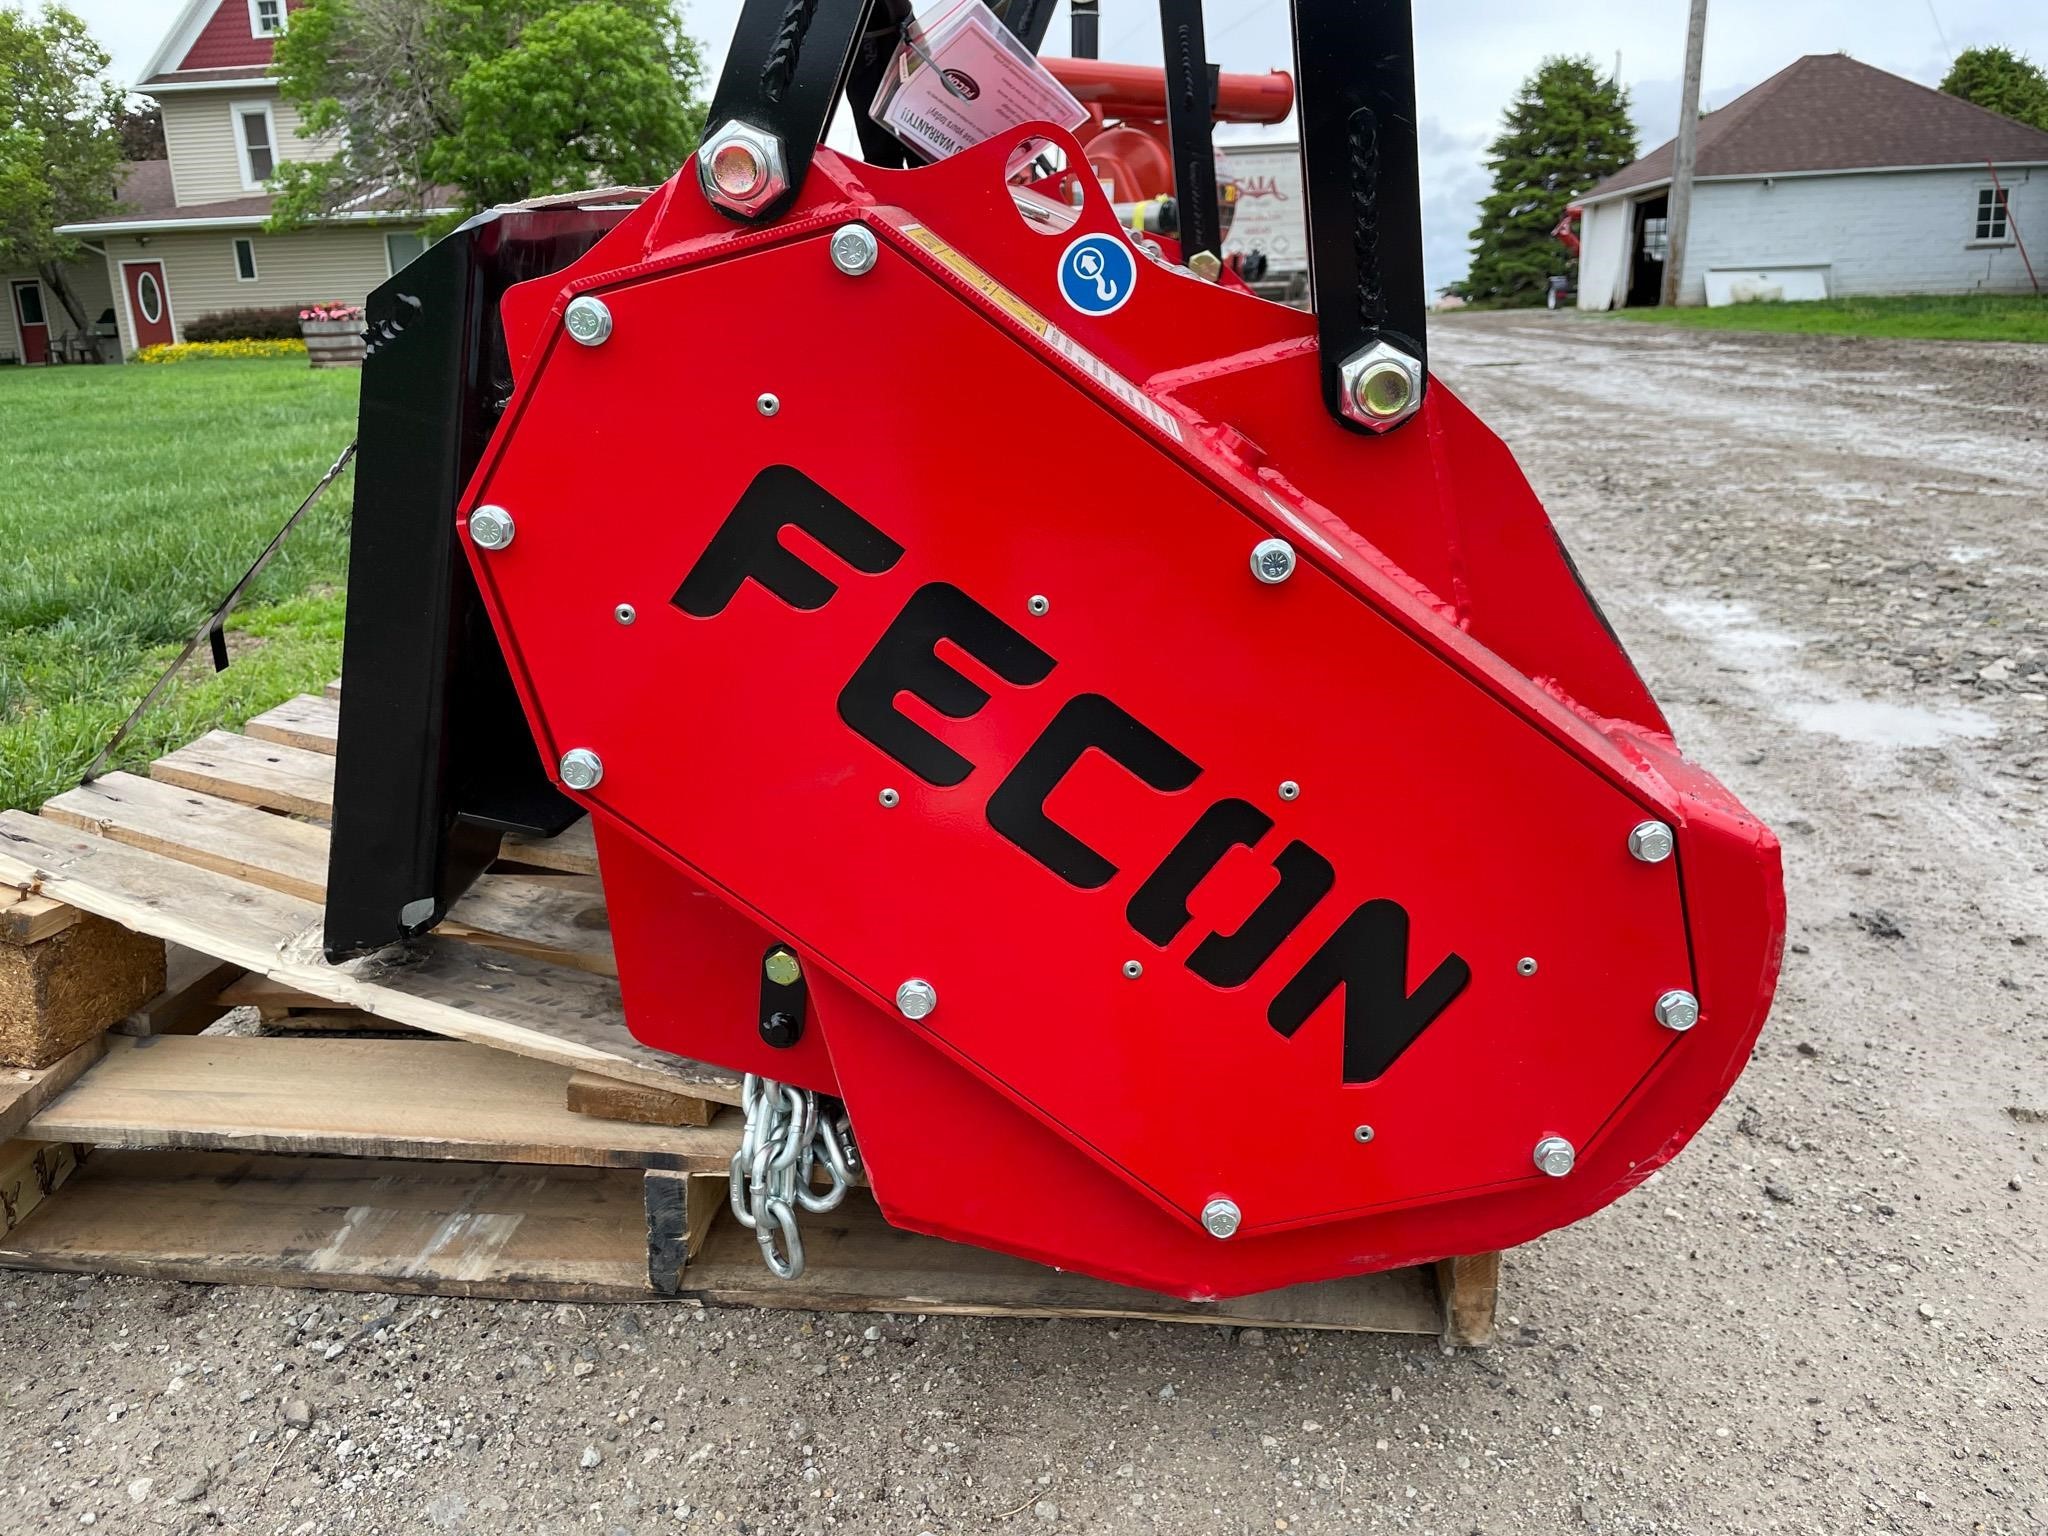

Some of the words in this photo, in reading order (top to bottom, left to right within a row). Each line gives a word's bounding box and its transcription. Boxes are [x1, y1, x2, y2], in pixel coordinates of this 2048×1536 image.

[945, 73, 976, 100] FECON
[900, 106, 957, 152] WARRANTY!!
[926, 106, 947, 126] today!
[945, 120, 965, 137] yours
[670, 464, 1471, 1085] FECON
